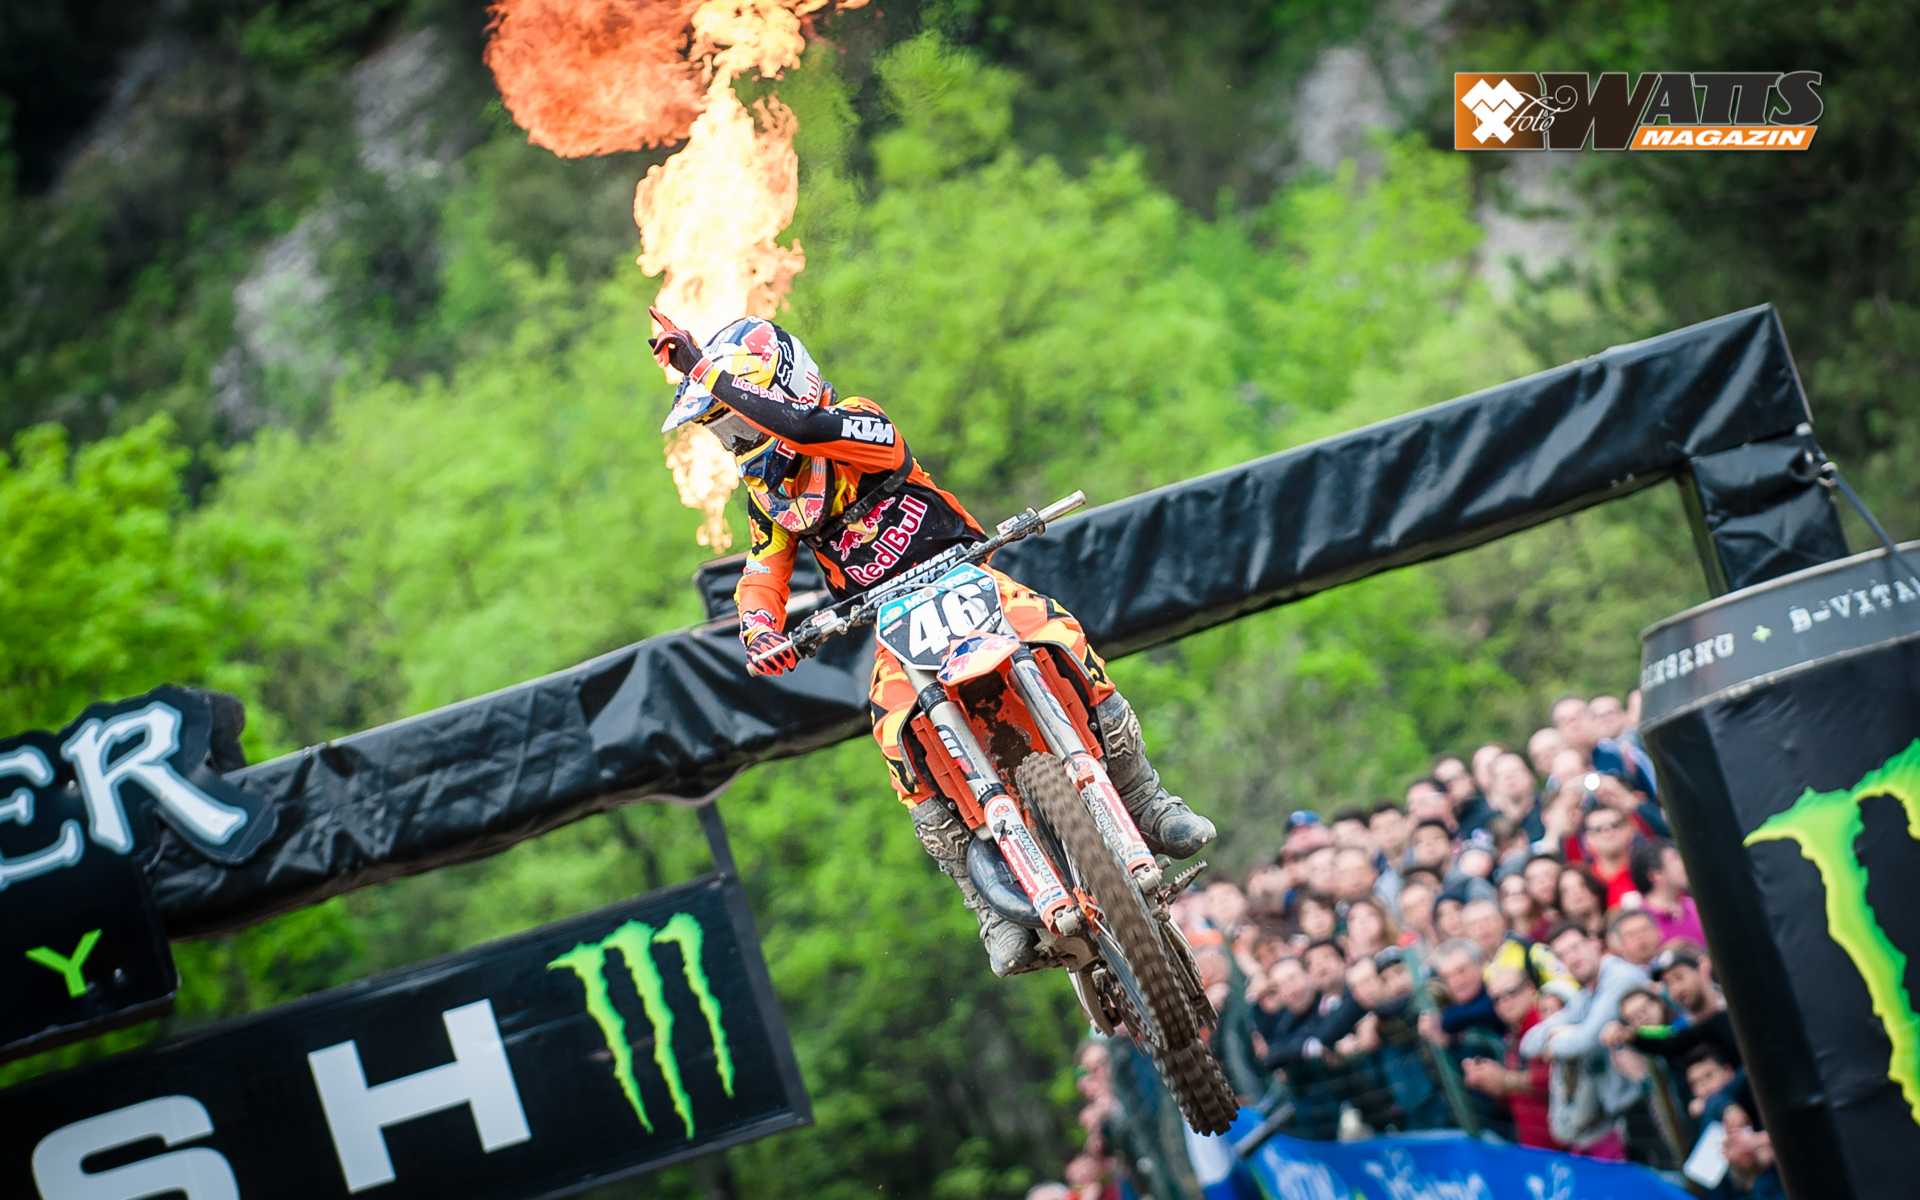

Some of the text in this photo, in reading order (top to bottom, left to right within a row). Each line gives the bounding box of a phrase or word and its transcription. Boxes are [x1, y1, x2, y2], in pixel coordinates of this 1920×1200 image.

[841, 415, 895, 444] KTM
[845, 541, 900, 586] Red
[880, 494, 928, 555] Bull
[909, 583, 991, 659] 46
[25, 929, 103, 998] Y
